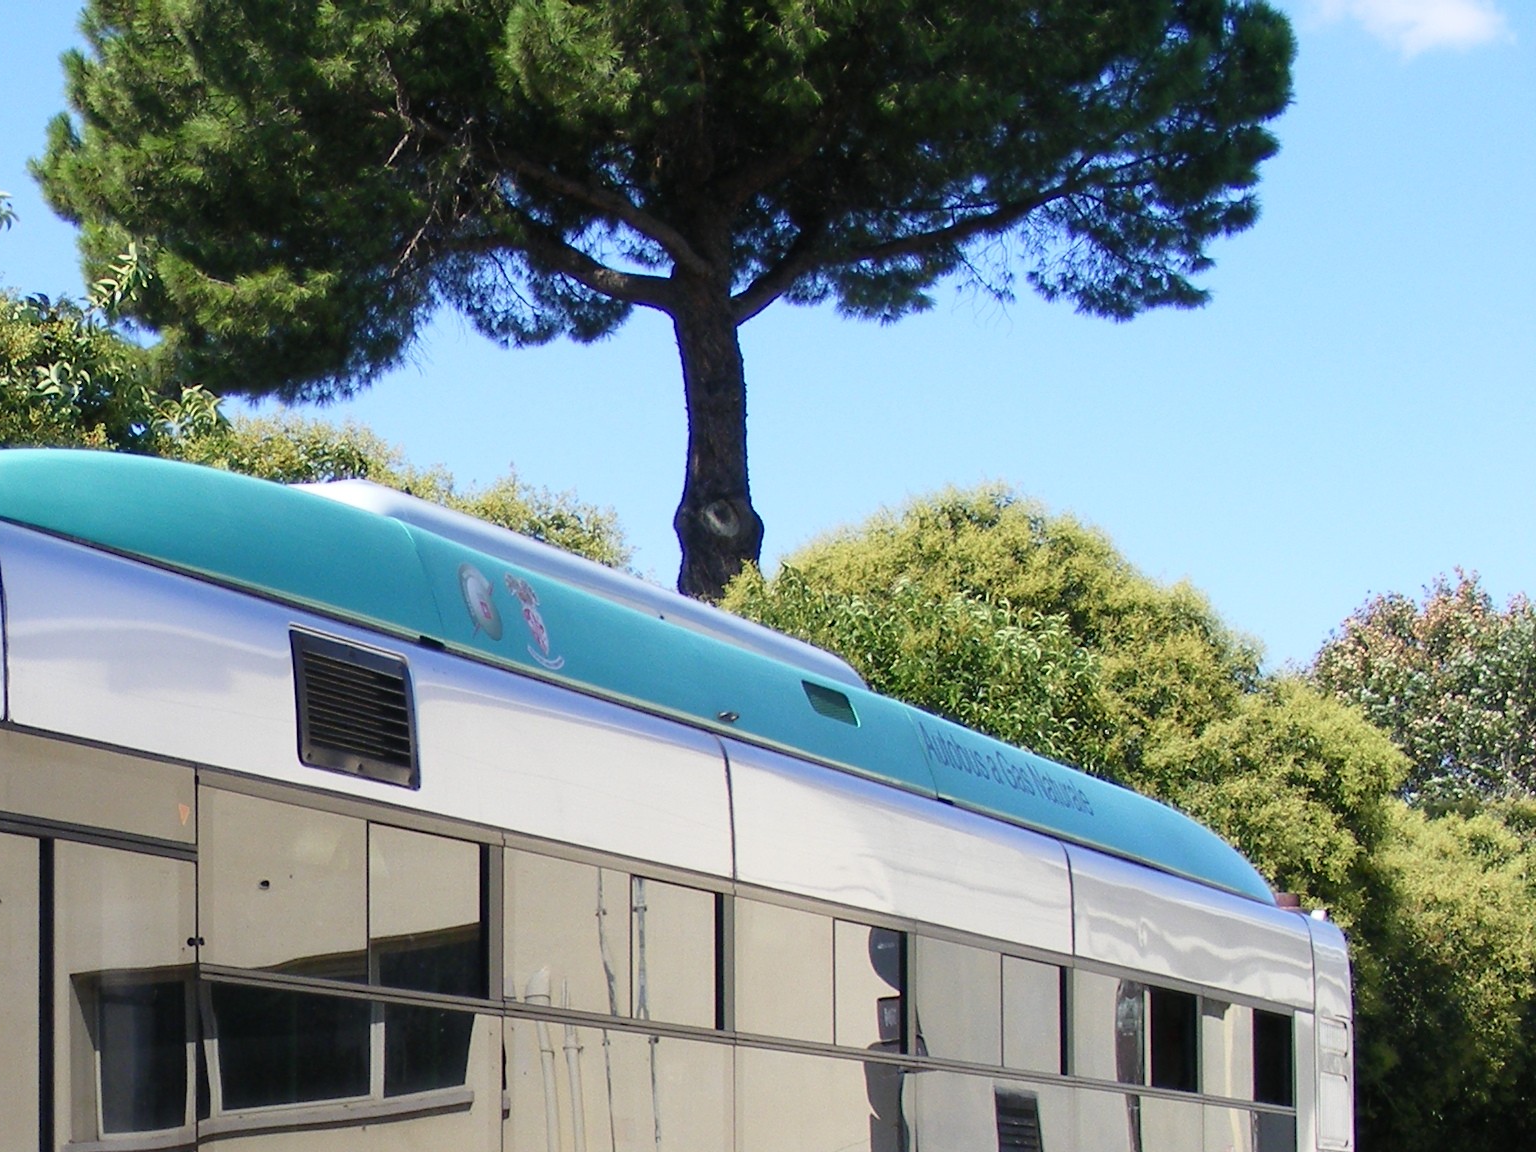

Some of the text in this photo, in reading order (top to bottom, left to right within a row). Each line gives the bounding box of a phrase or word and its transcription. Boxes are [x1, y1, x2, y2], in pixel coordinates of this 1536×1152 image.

[919, 720, 990, 781] Autobus
[995, 750, 1036, 797] Gas
[1025, 761, 1095, 817] Naturale
